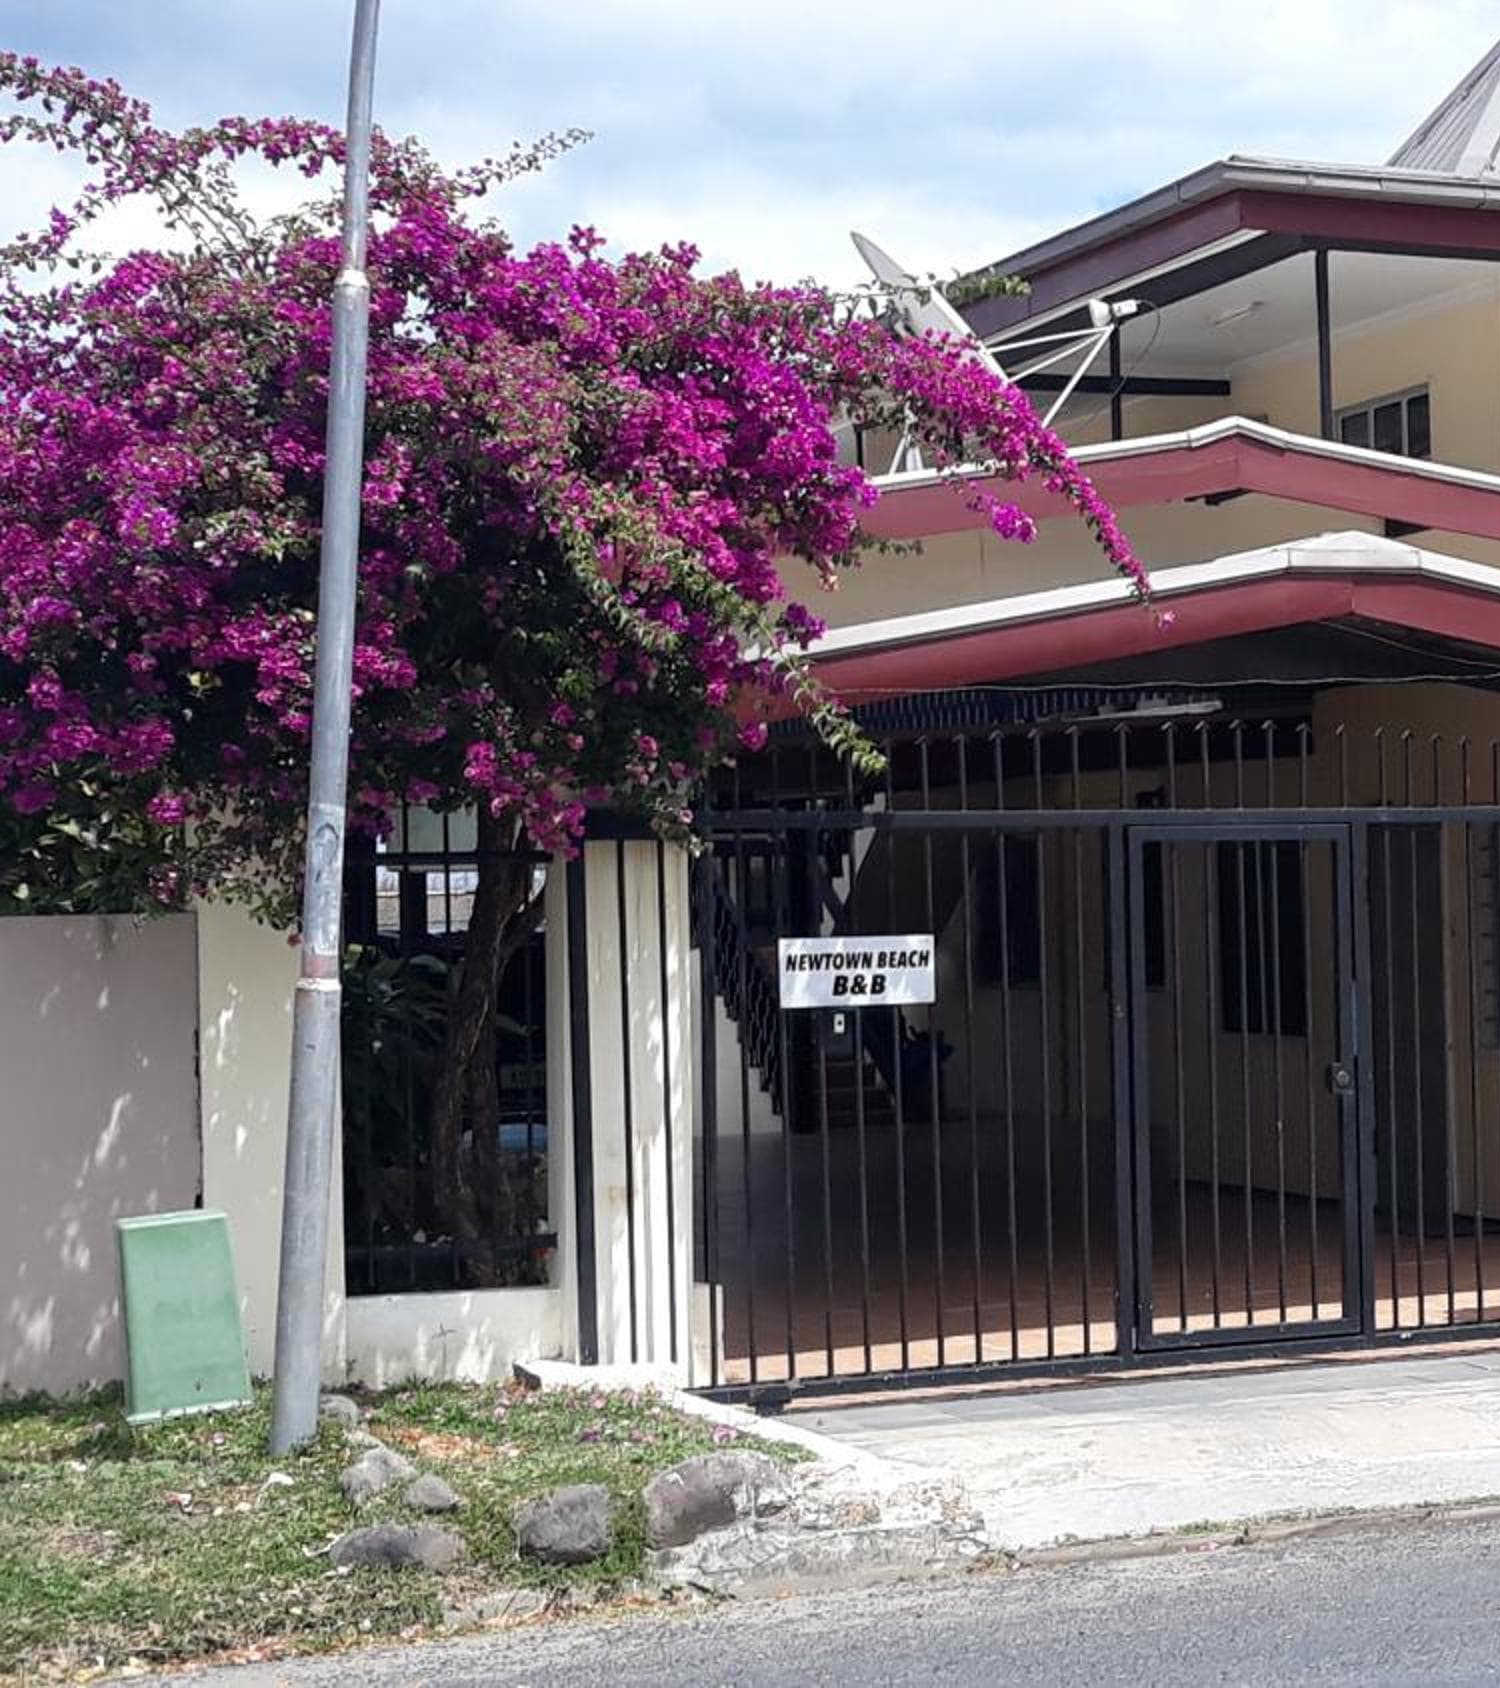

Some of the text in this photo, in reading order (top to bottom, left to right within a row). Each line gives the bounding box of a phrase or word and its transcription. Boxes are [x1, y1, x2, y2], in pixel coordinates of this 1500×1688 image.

[785, 949, 930, 972] NEWTOWN BEACH
[832, 974, 887, 996] B&B
